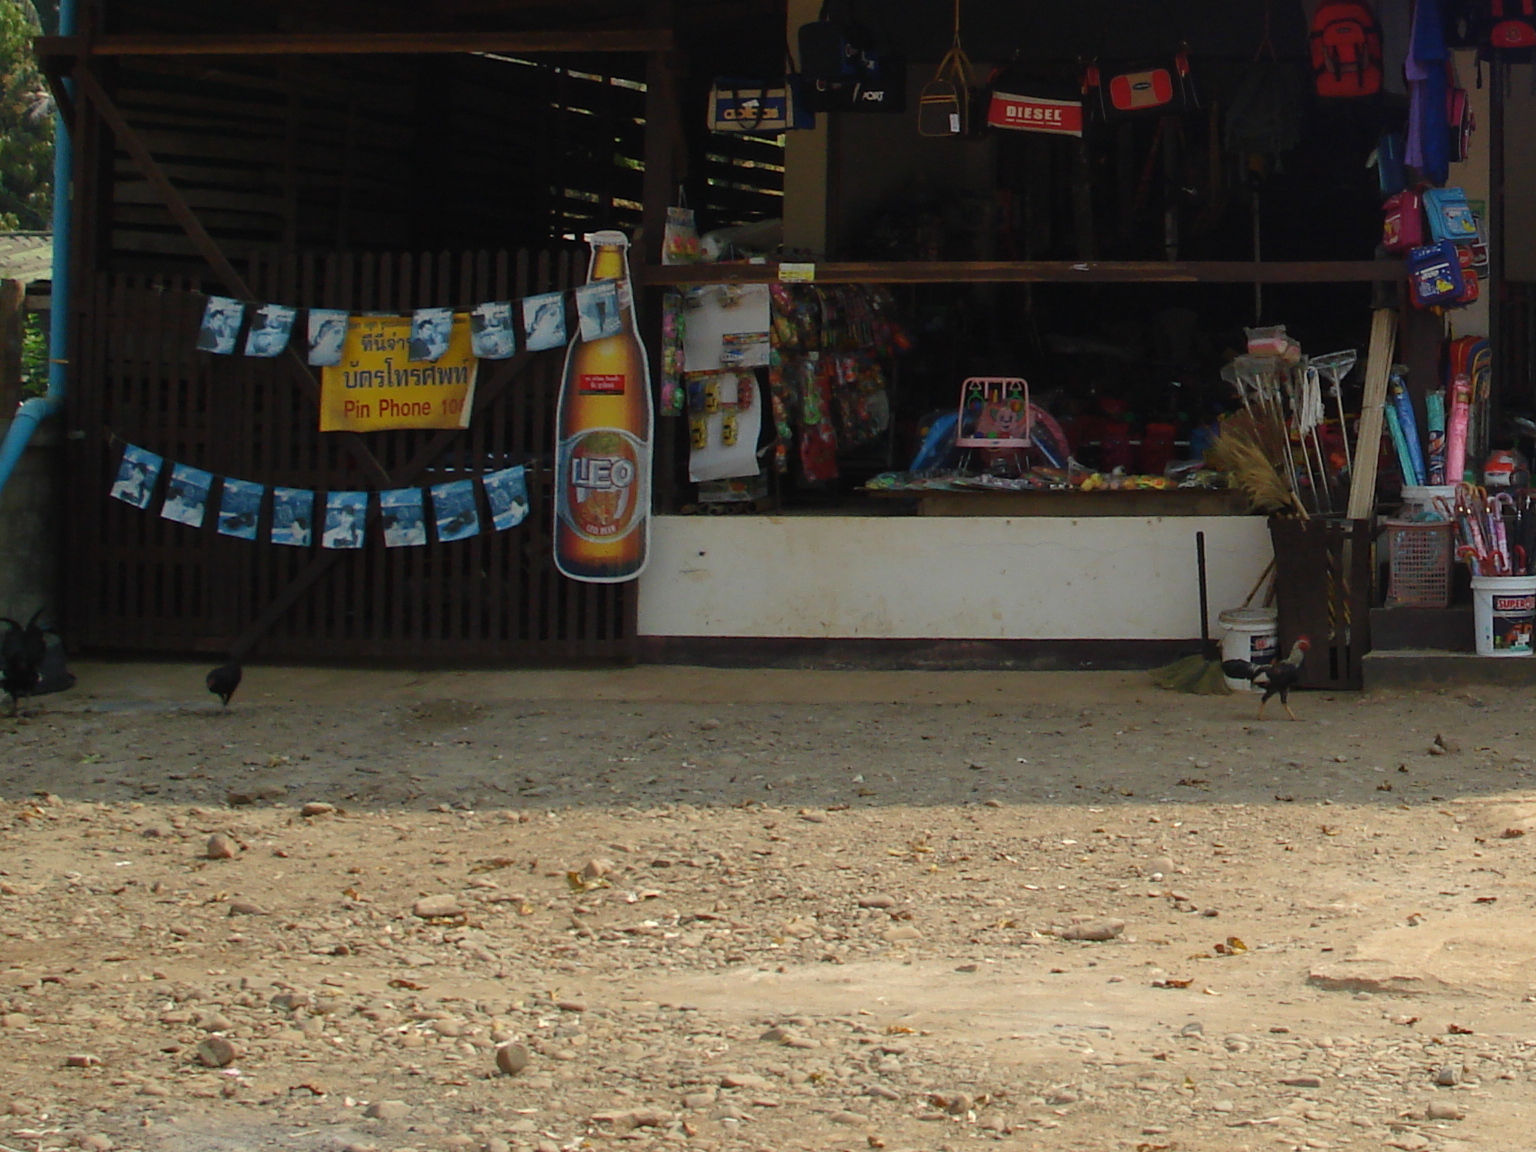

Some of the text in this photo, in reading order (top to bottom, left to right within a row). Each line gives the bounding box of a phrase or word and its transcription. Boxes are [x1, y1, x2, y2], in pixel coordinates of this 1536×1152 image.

[1006, 105, 1062, 121] DIESEL
[344, 400, 370, 419] Pin
[379, 398, 431, 418] Phone
[571, 457, 635, 489] LEO
